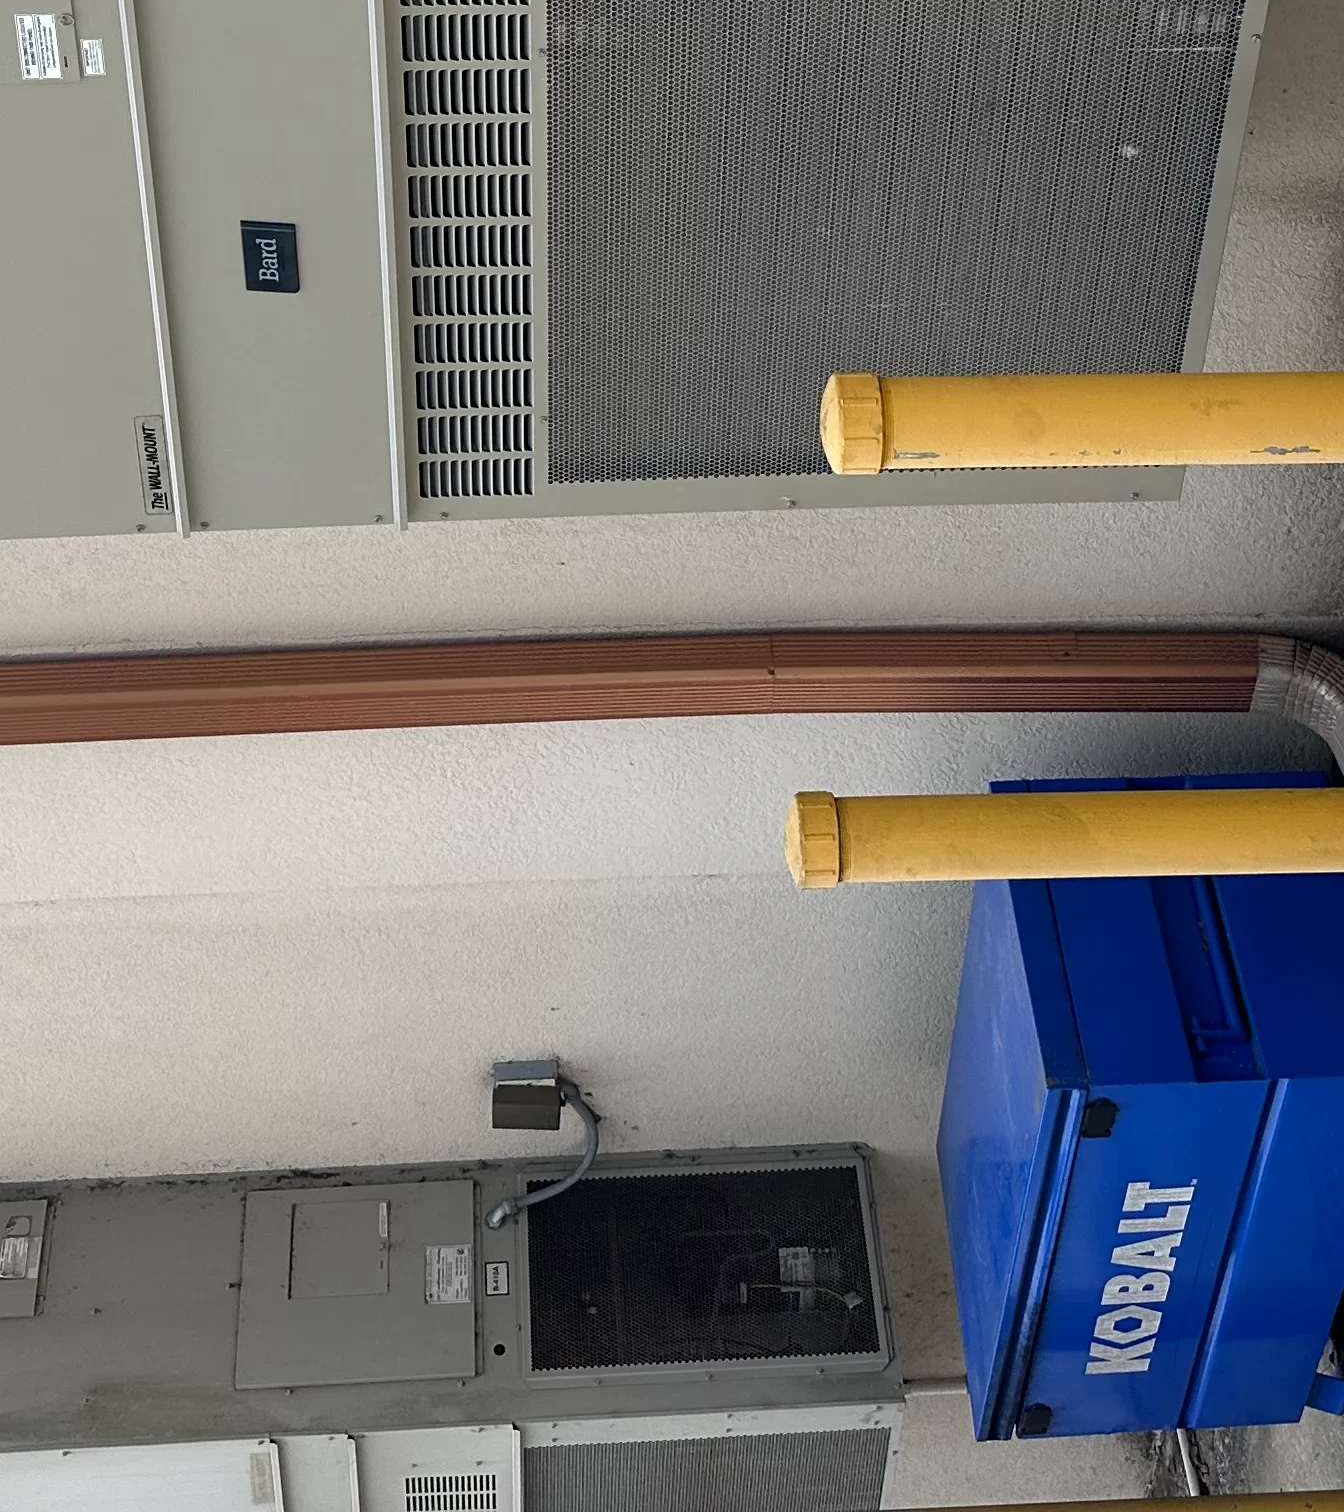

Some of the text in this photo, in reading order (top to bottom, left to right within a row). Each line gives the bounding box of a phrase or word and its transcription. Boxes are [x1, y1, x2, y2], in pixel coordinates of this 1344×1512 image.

[255, 238, 279, 282] Bard
[142, 425, 164, 510] The WALL-MOUNT
[1084, 1182, 1195, 1375] KOBALT
